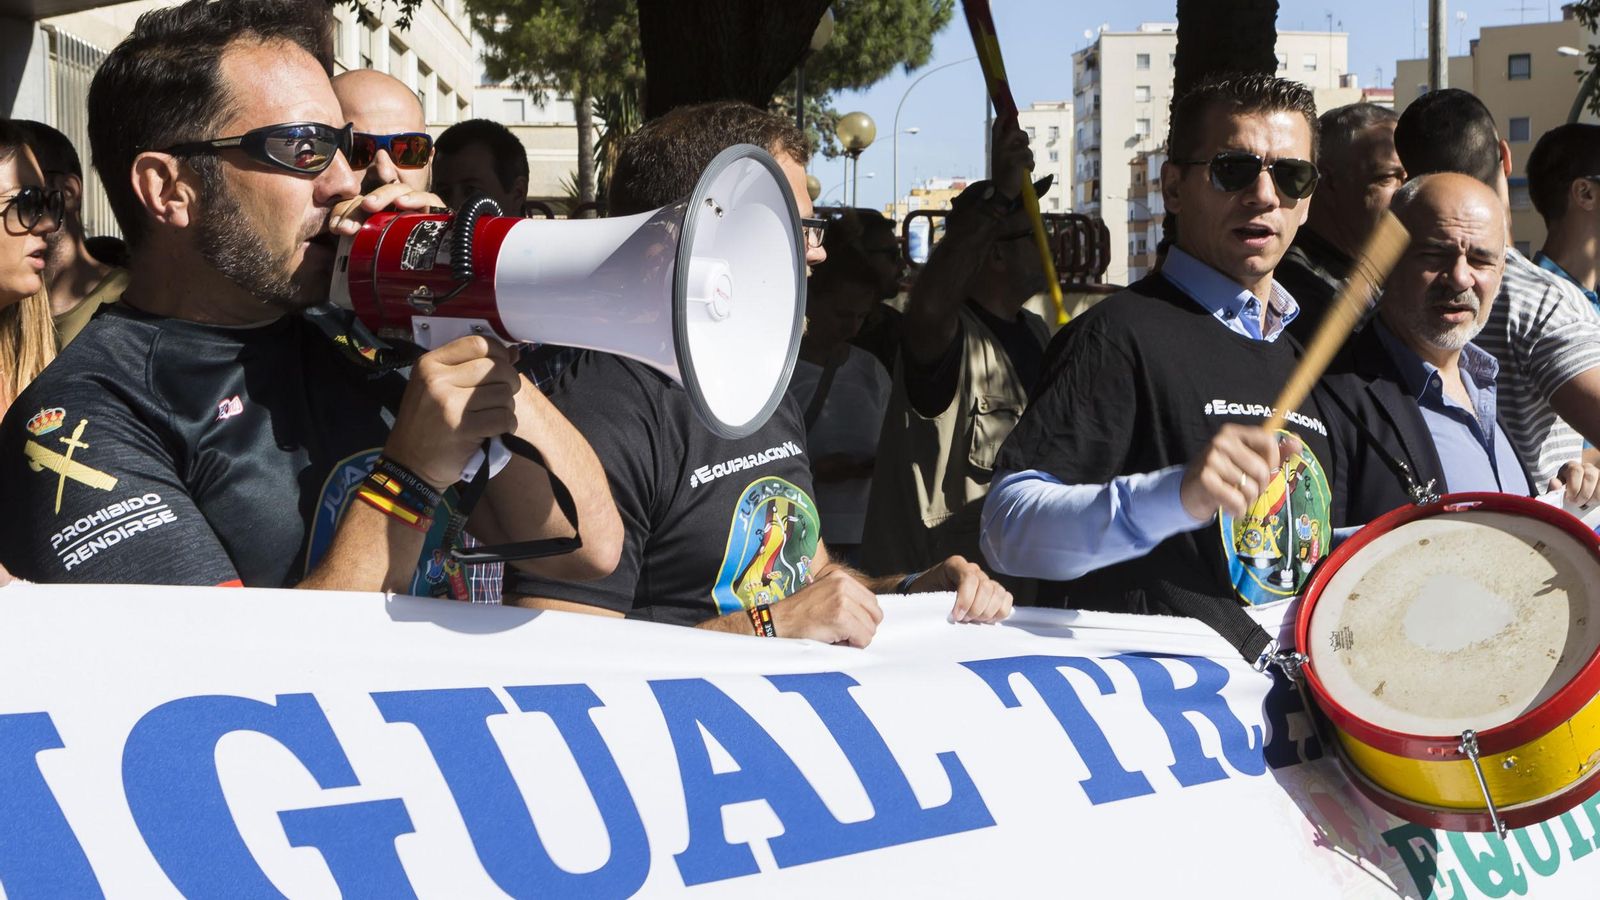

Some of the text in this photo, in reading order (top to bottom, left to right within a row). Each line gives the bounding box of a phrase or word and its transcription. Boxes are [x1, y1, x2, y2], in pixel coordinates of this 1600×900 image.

[1204, 399, 1328, 437] #EQUIPAACIONYA
[50, 493, 162, 550] PROHIBIDO
[62, 508, 178, 572] RENDIRSE
[0, 671, 998, 900] IGUAL
